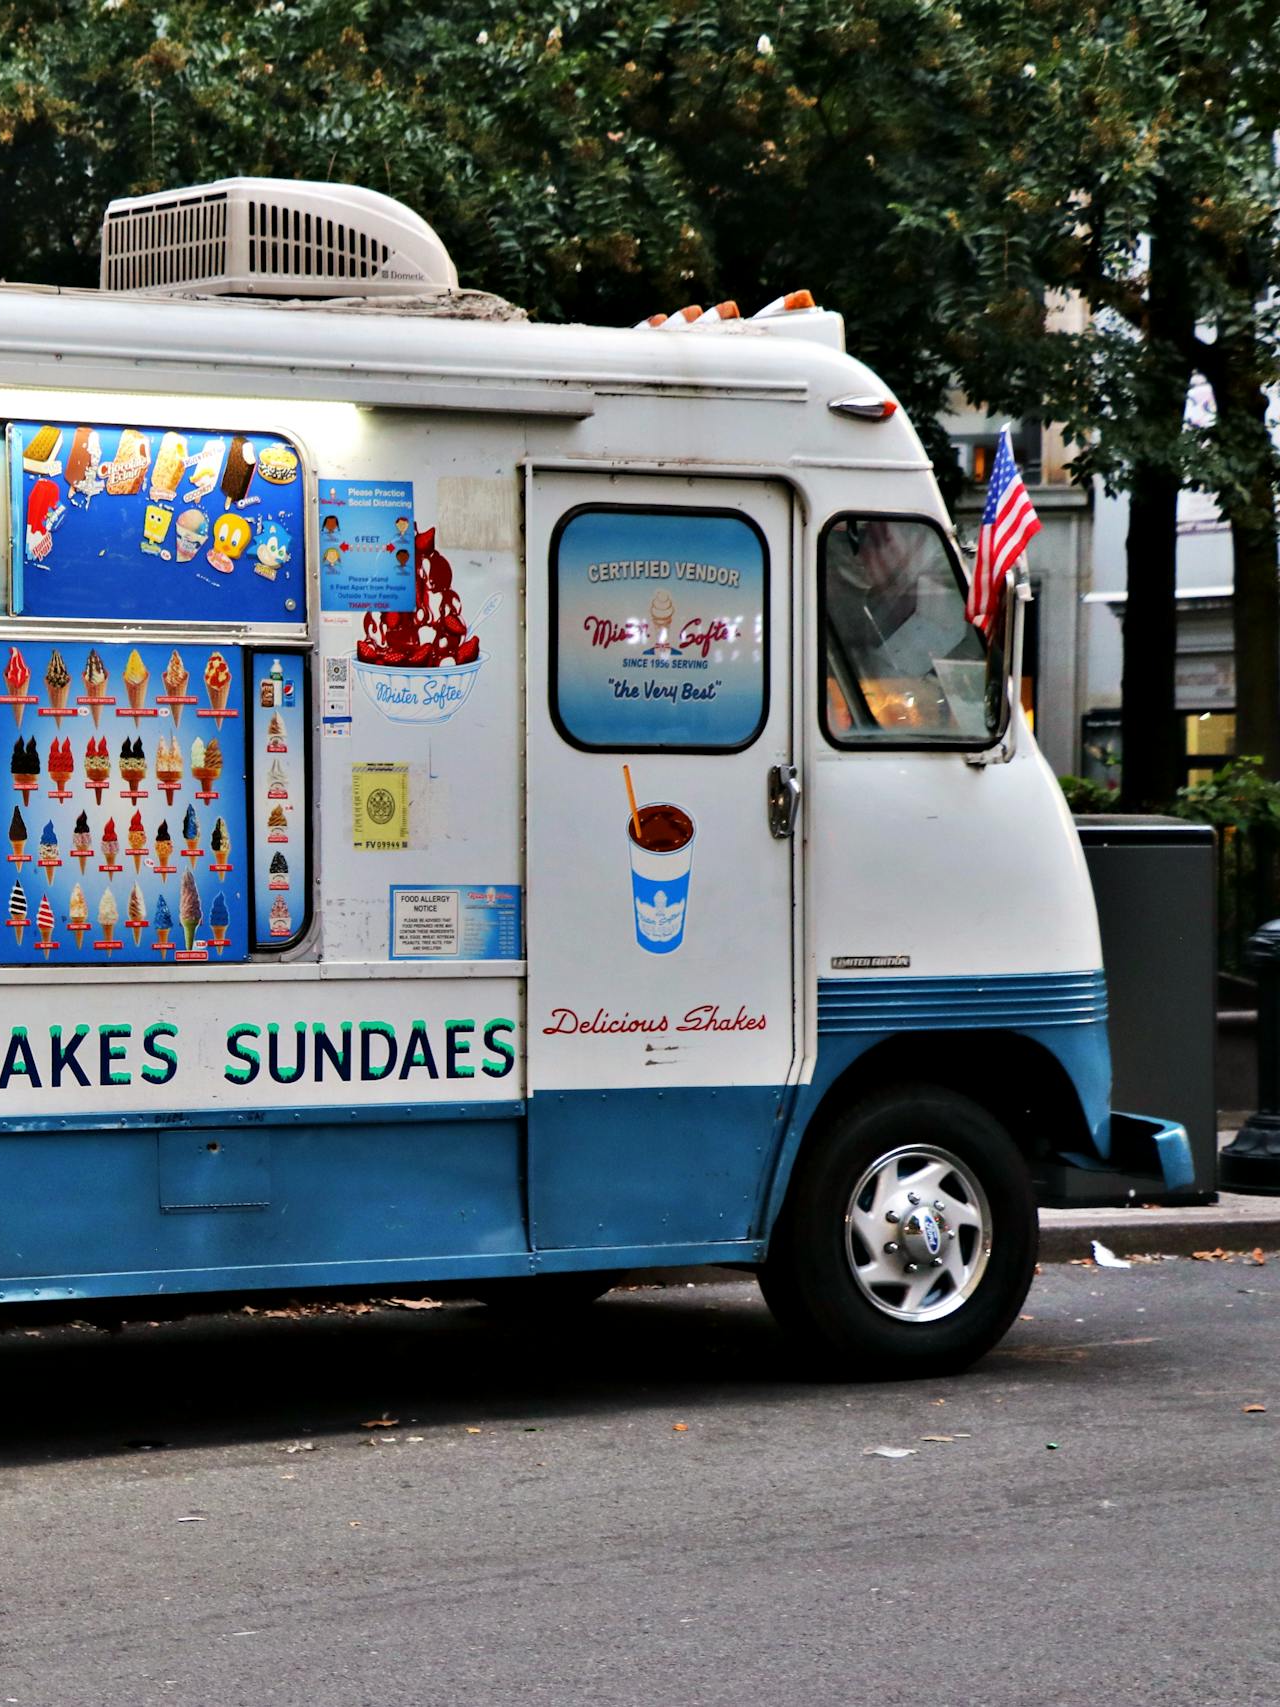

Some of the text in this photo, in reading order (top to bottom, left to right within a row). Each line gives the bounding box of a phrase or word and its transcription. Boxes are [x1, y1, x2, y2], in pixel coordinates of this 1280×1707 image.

[348, 488, 405, 497] Please Practice
[348, 499, 371, 507] Social
[373, 500, 412, 509] Distancing
[588, 561, 740, 587] CERTIFIED VENDOR
[584, 616, 741, 657] Misr Softe
[623, 658, 708, 669] SINCE 1956 SERVING
[376, 681, 463, 709] Mister Softee
[608, 678, 722, 703] "the Very Best"
[543, 1005, 767, 1035] Delicious Shakes
[225, 1018, 516, 1085] SUNDAES
